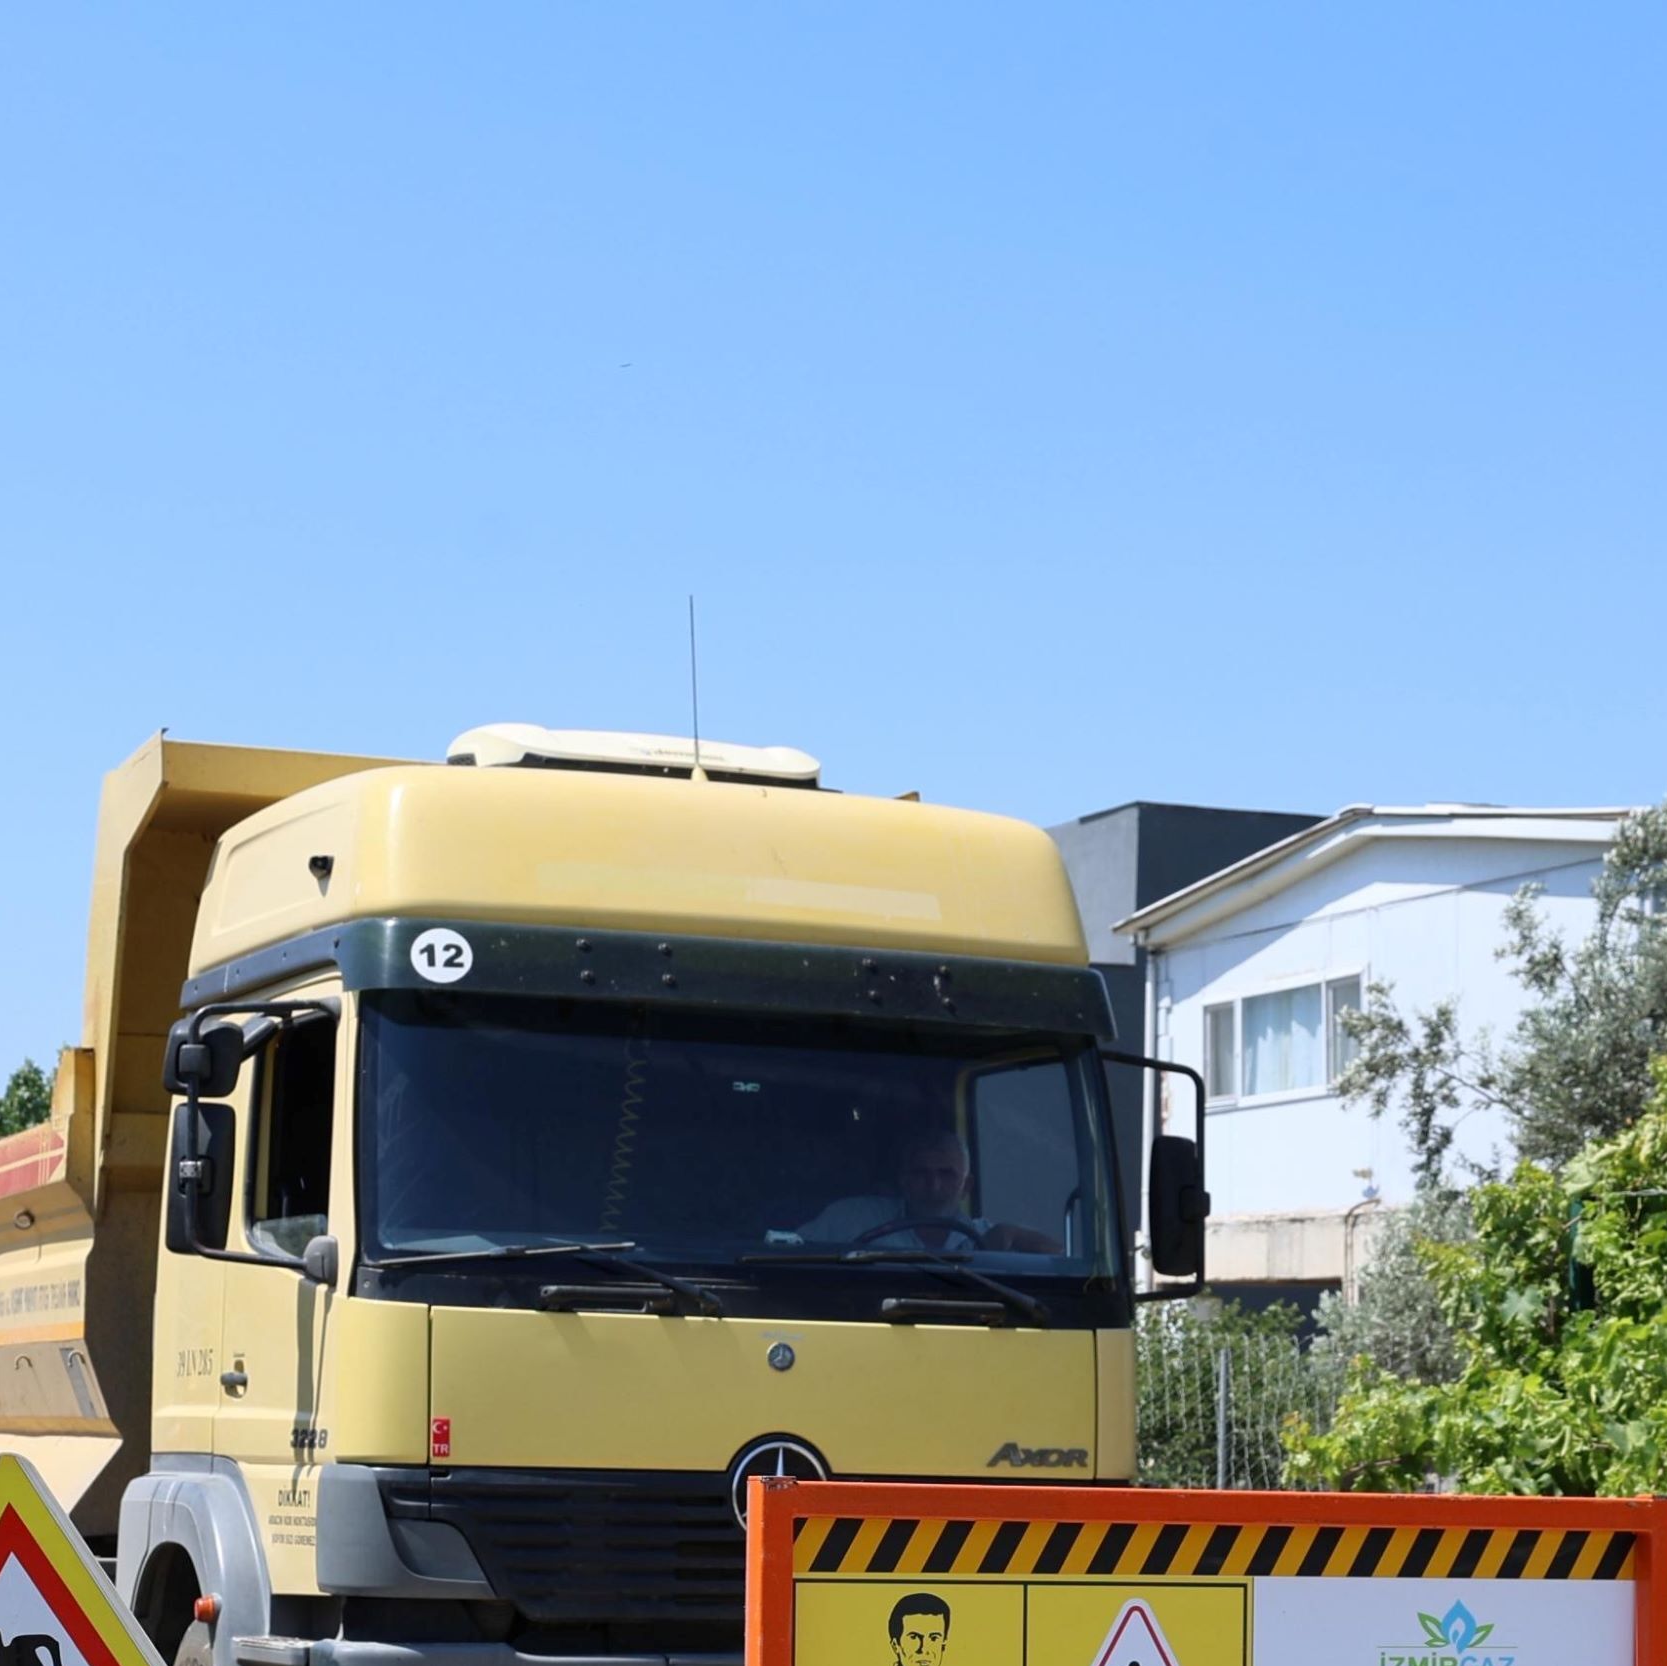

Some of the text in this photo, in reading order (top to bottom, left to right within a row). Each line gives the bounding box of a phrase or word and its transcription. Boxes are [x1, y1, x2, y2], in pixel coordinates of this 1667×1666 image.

[419, 943, 464, 969] 12
[290, 1428, 328, 1449] 3228
[434, 1443, 449, 1455] TR
